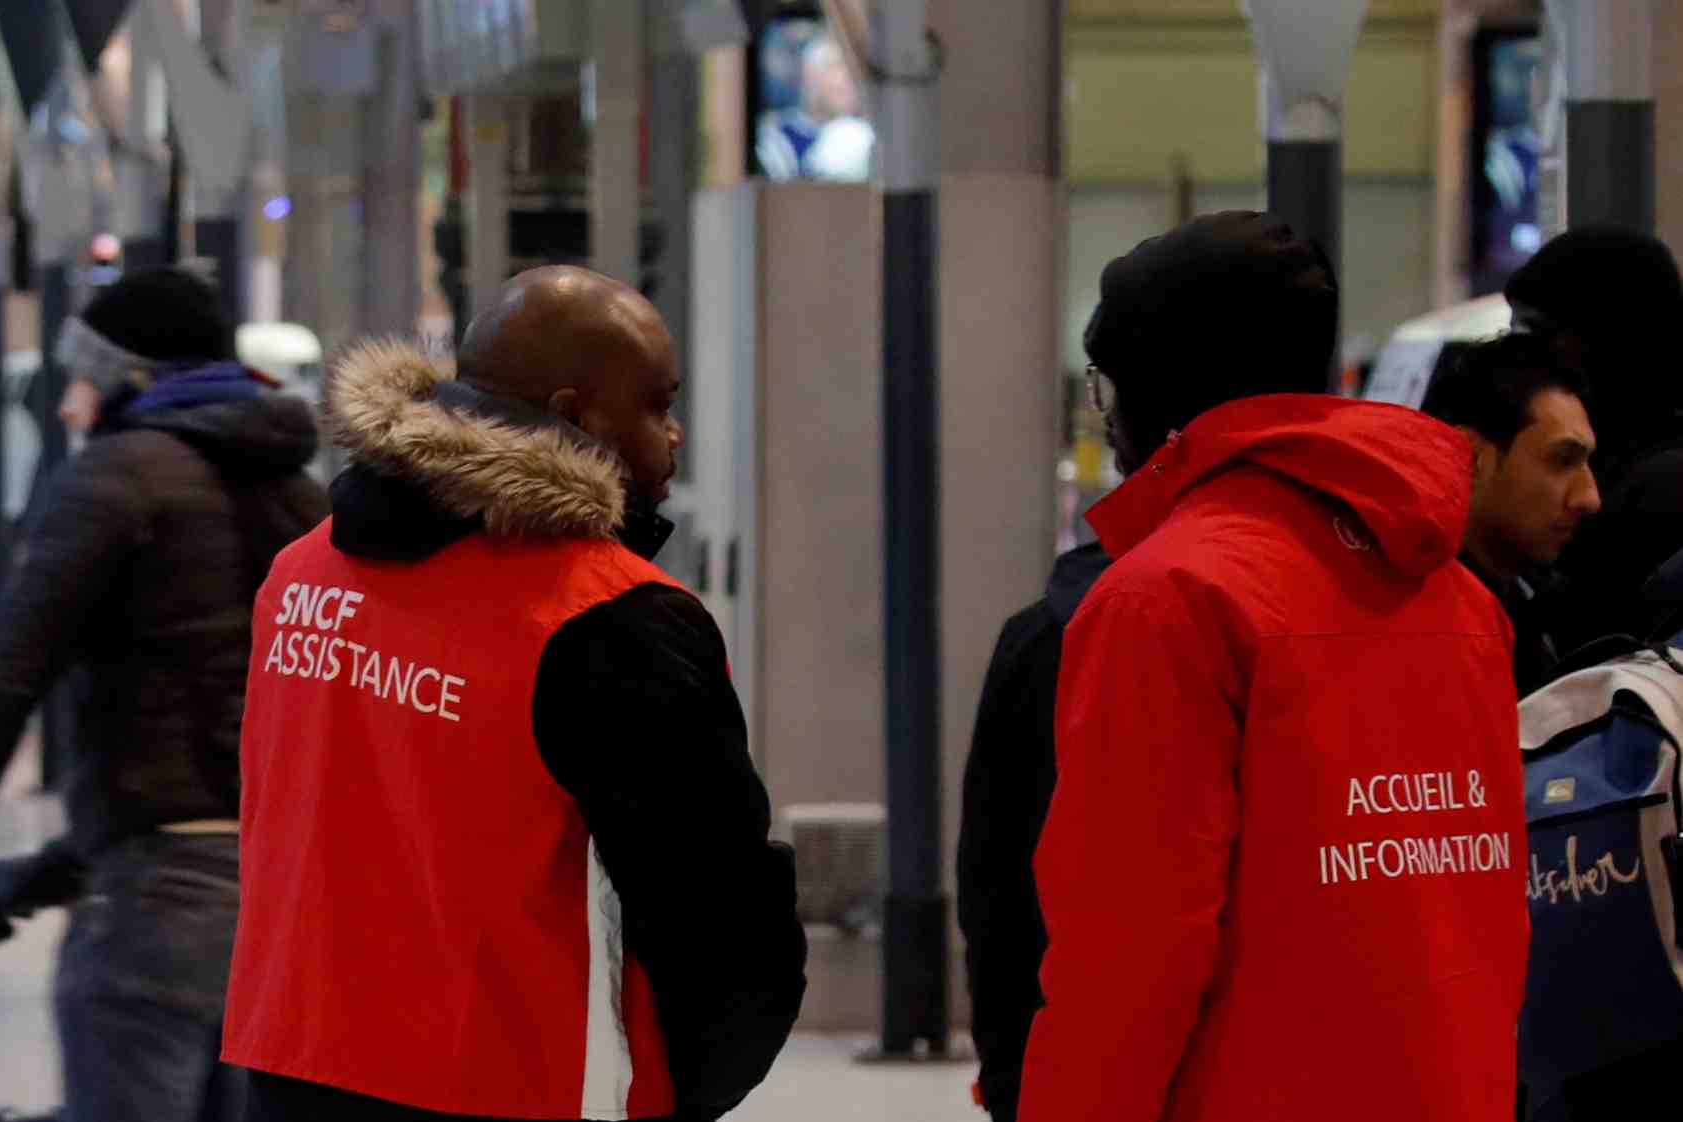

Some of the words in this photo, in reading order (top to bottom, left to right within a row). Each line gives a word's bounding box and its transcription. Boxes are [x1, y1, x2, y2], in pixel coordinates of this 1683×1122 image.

[274, 581, 365, 632] SNCF
[264, 629, 467, 722] ASSISTANCE
[1346, 771, 1464, 817] ACCUEIL
[1468, 769, 1486, 808] &
[1319, 832, 1511, 885] INFORMATION
